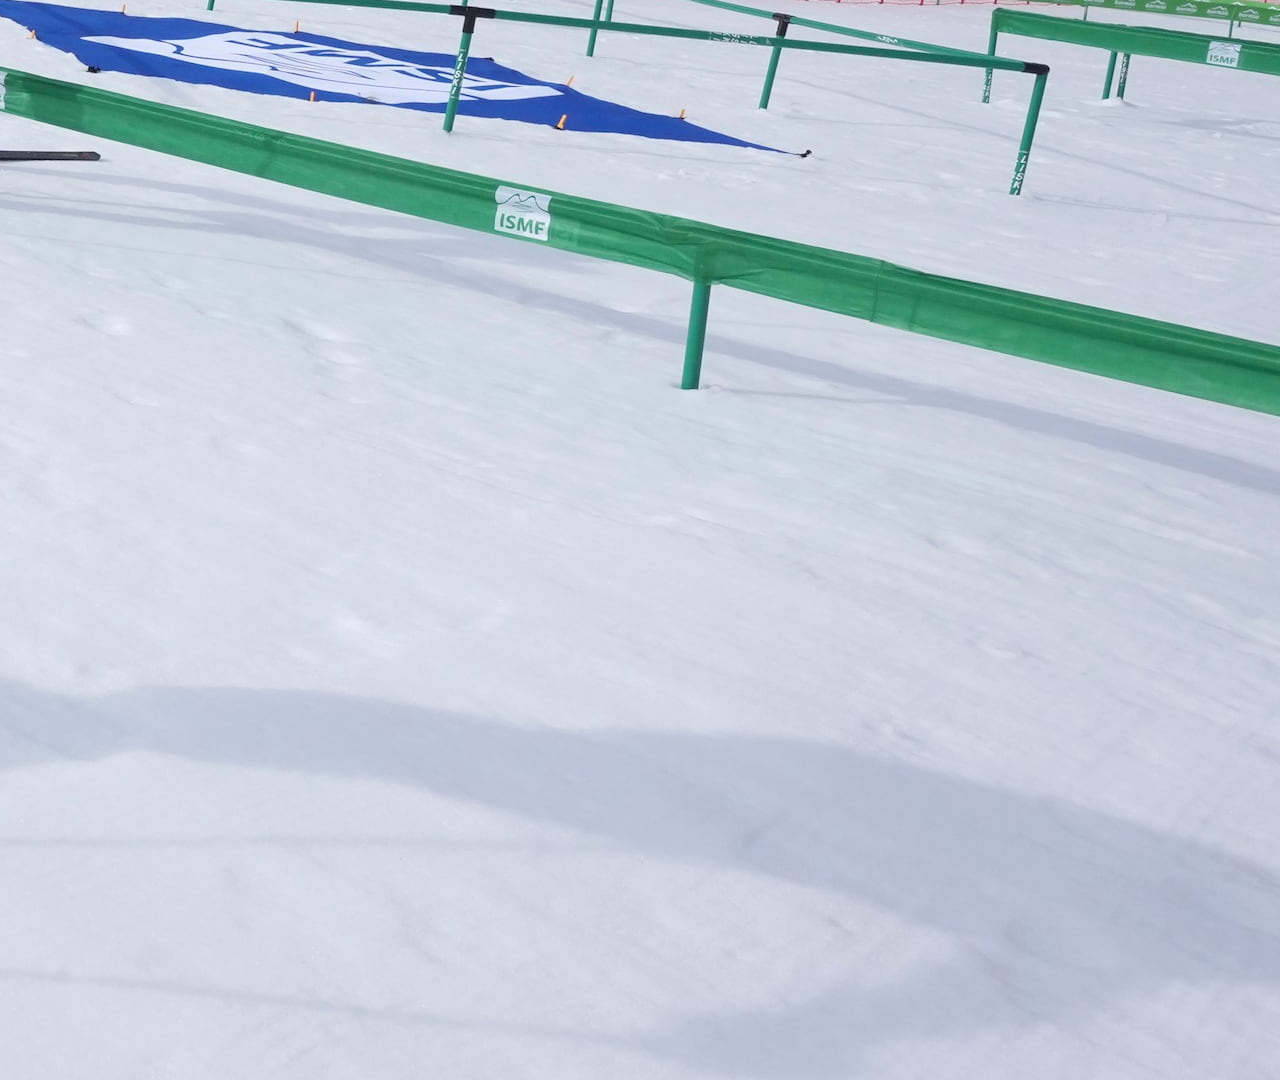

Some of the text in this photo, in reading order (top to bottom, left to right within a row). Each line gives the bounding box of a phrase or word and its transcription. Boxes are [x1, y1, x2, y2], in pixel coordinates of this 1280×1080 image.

[1208, 54, 1237, 66] ISMF
[450, 52, 466, 96] LISKI
[499, 213, 546, 235] ISMF
